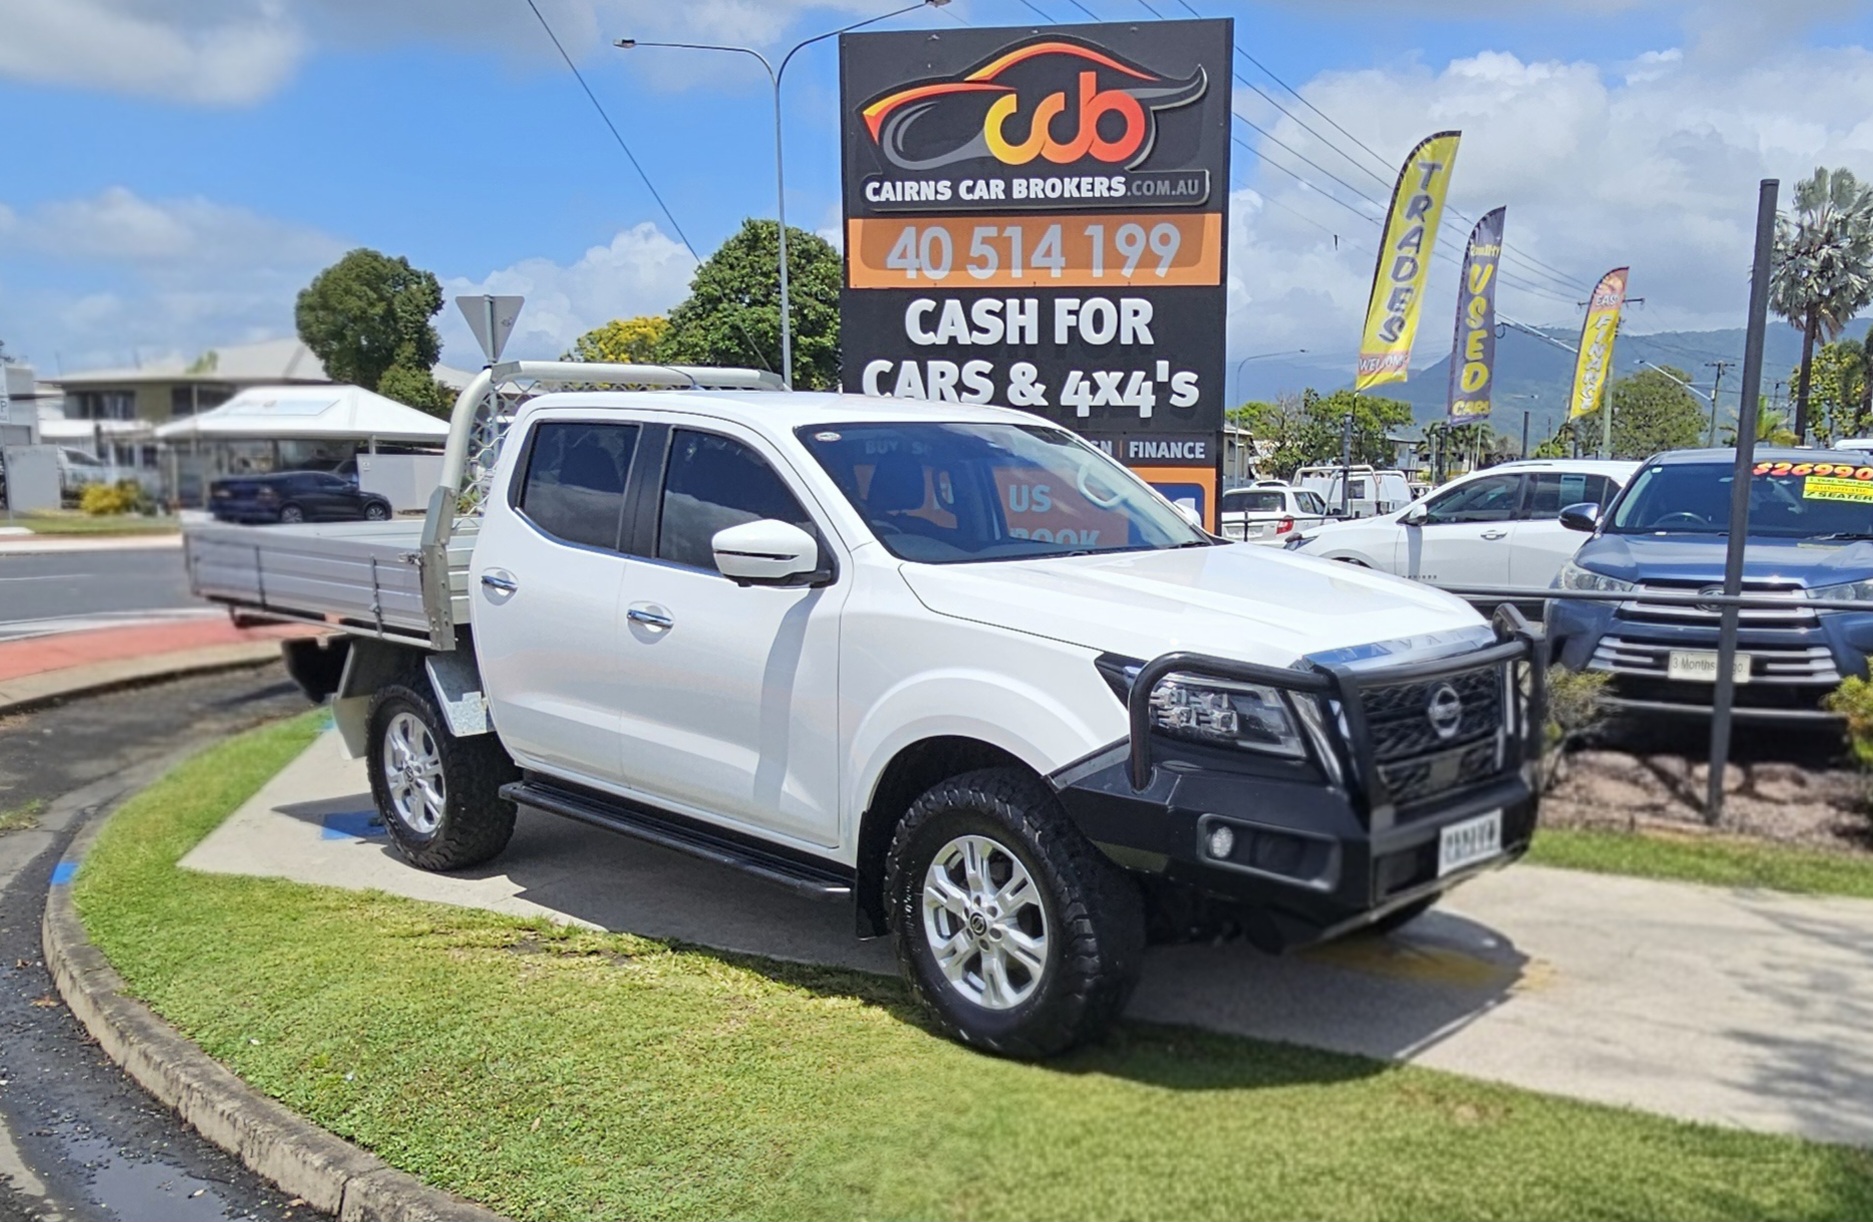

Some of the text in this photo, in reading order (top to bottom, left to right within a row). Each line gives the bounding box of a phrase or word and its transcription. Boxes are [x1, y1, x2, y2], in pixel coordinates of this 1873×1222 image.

[865, 177, 1200, 203] CAIRNS CAR BROKERS .COM.AU
[886, 223, 1181, 280] 40 514 199
[1378, 161, 1443, 344] TRADES
[904, 298, 1155, 346] CASH FOR
[1460, 263, 1494, 393] USED
[862, 359, 995, 406] CARS
[1007, 361, 1049, 407] &
[1129, 441, 1206, 459] FINANCE
[1009, 484, 1052, 513] US
[1672, 657, 1679, 669] 3
[1681, 657, 1717, 671] Months
